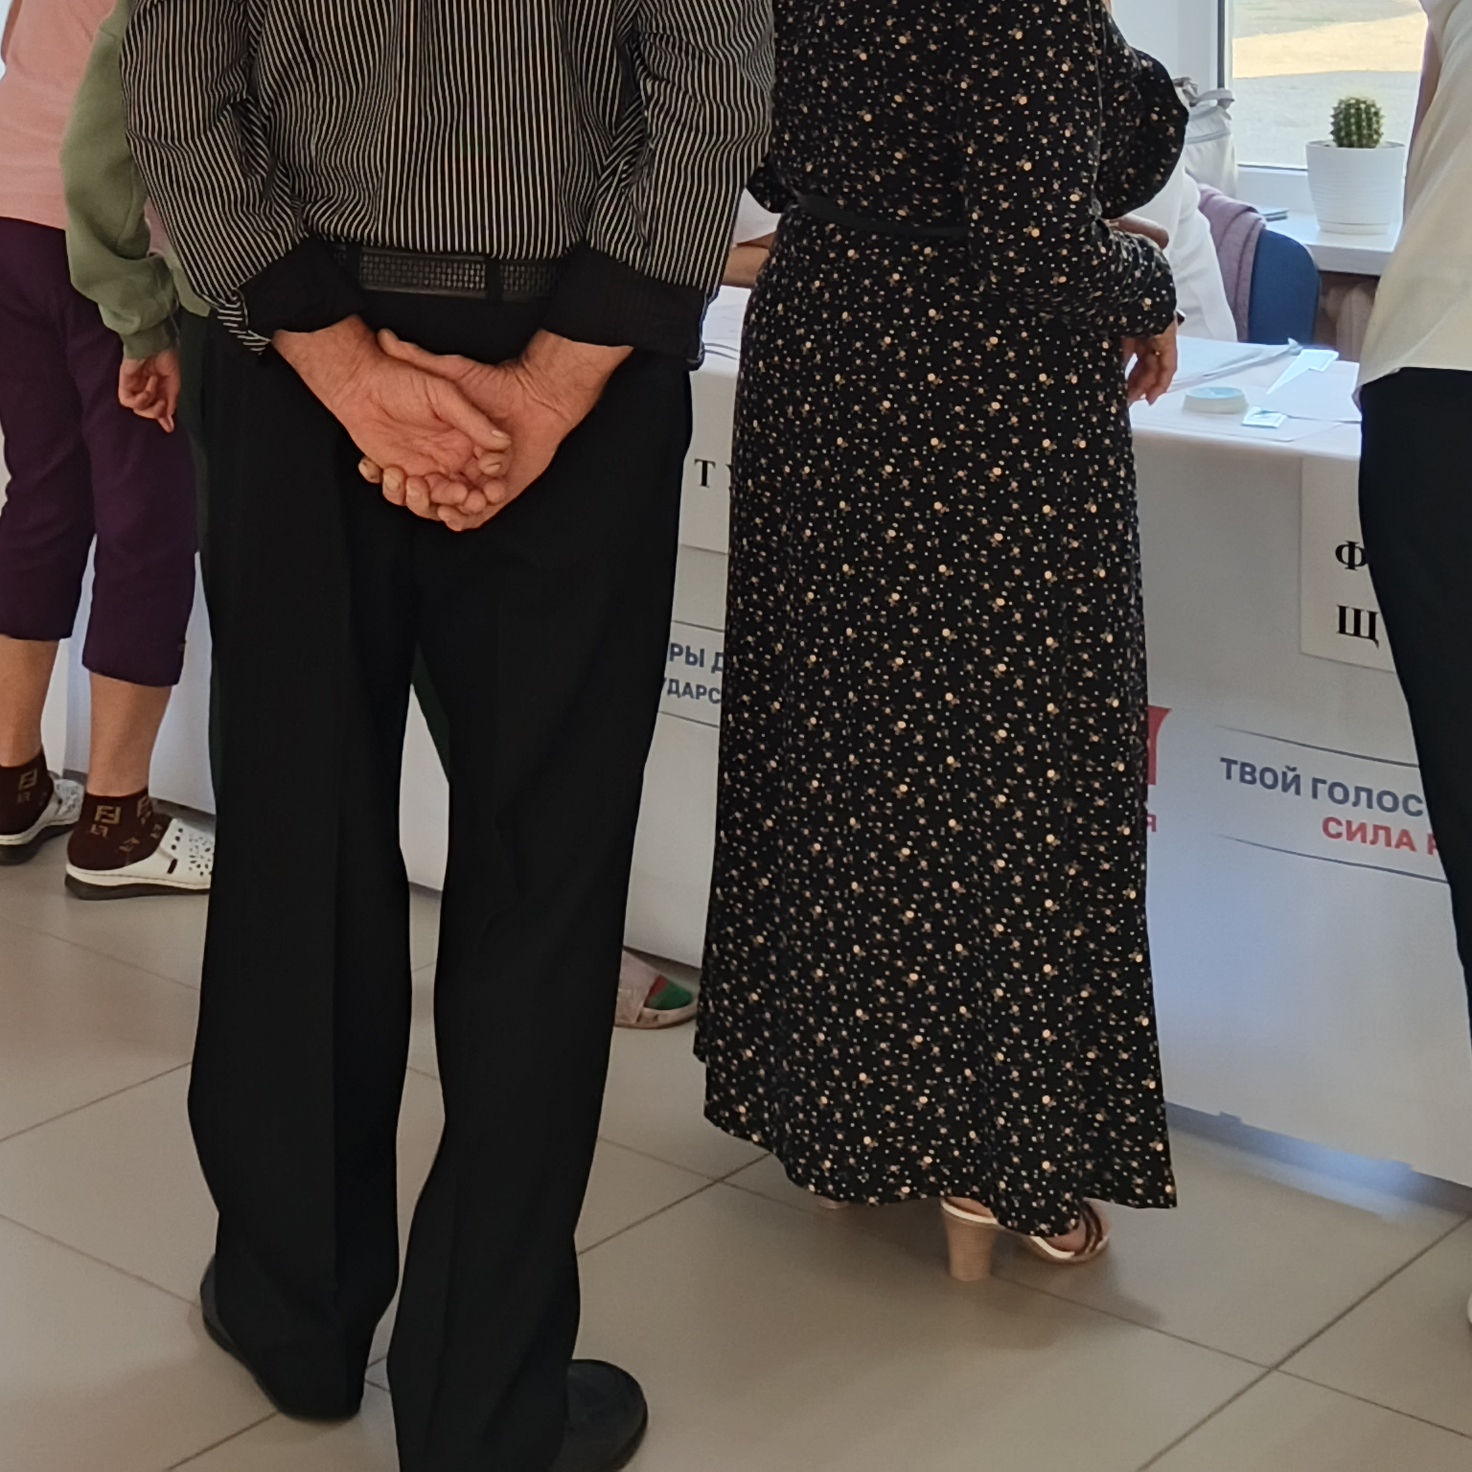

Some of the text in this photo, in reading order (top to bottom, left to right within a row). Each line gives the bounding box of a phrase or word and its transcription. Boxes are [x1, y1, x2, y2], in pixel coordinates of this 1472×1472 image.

[1220, 756, 1424, 817] ТВОЙ ГОЛОС
[1321, 816, 1417, 853] СИЛА
